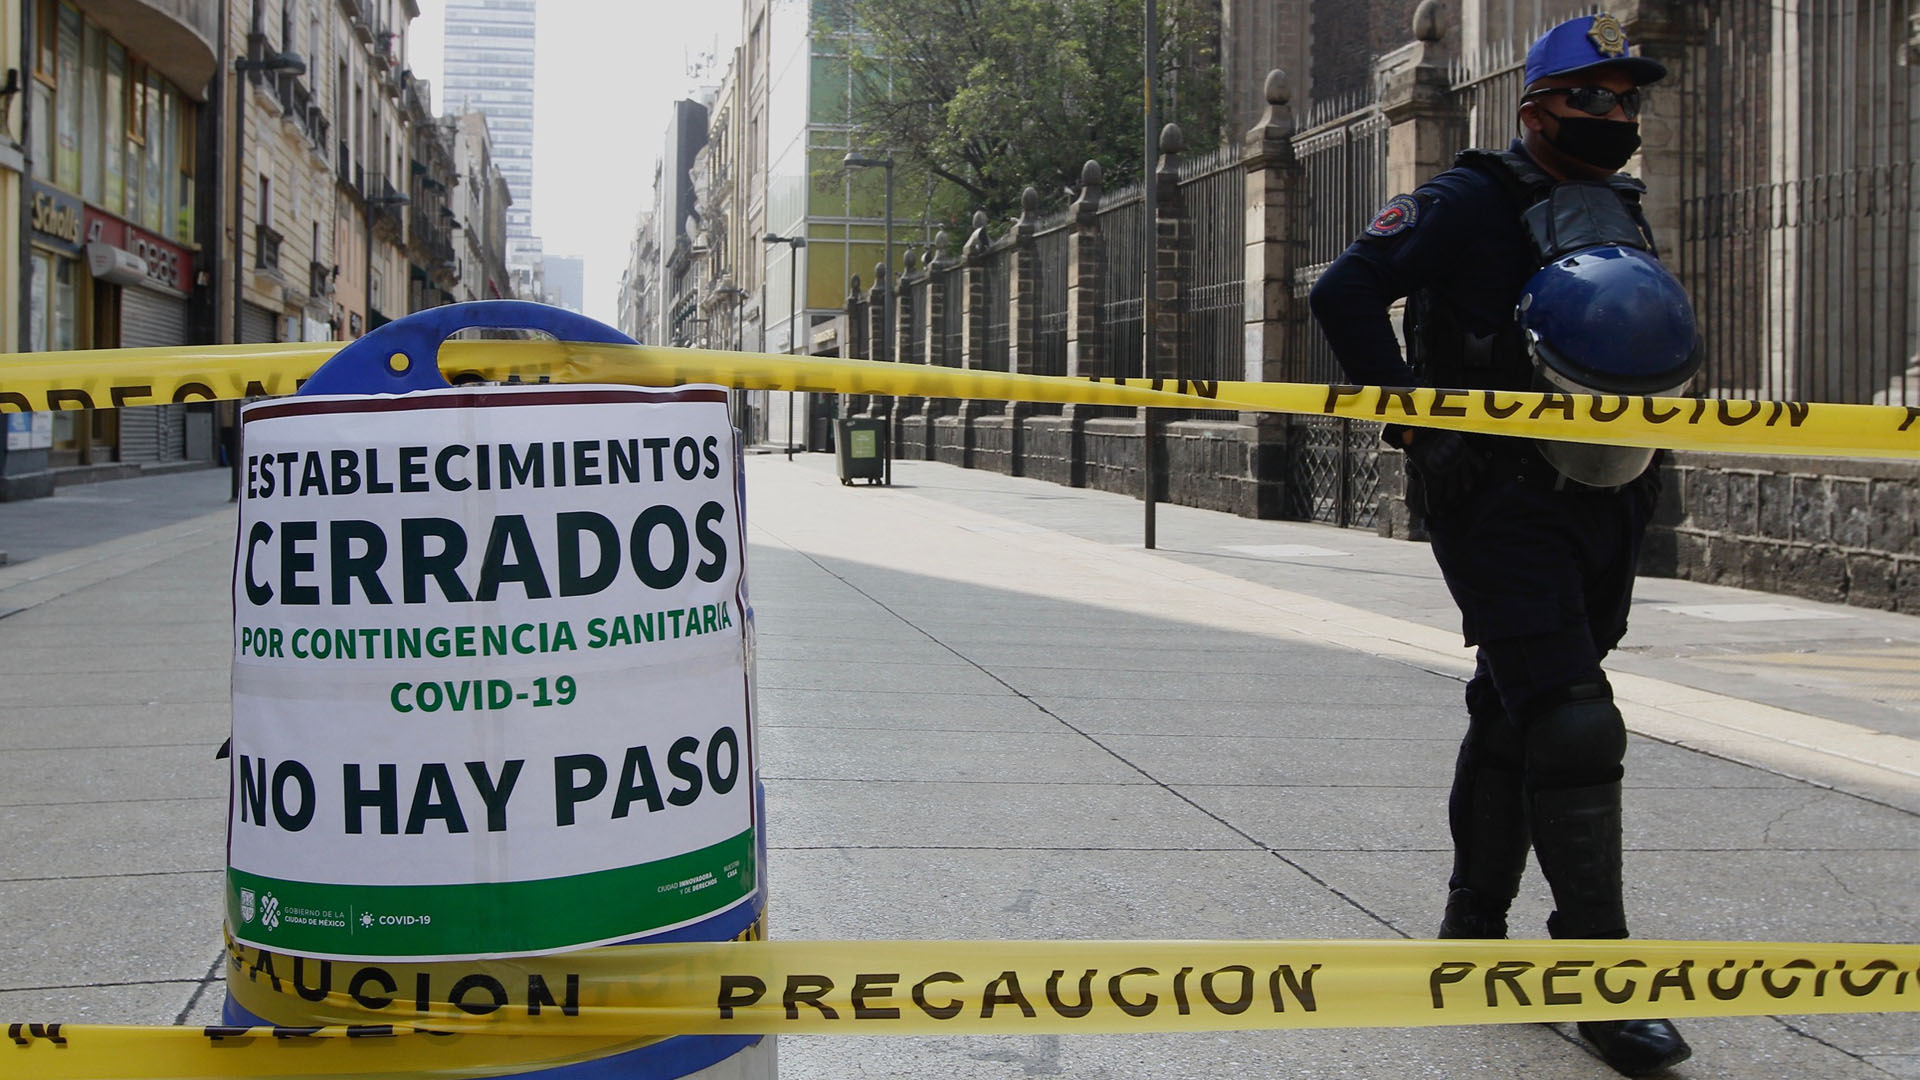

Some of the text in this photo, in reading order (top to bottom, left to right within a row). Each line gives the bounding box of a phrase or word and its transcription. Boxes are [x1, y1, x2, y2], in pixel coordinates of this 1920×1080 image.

[247, 435, 721, 500] ESTABLECIMIENTOS
[244, 500, 728, 607] CERRADOS
[241, 600, 734, 660] POR CONTINGENCIA SANITARIA
[390, 675, 578, 713] COVID-19
[239, 726, 740, 835] NO HAY PASO
[657, 871, 713, 893] CIUDAD INNOVADORA
[692, 877, 718, 892] DERECHOS
[284, 906, 320, 917] GOBIERNO
[335, 911, 345, 919] LA
[284, 916, 308, 924] CIUDAD
[318, 917, 346, 928] MÉXICO
[378, 915, 432, 926] COVID-19
[232, 944, 580, 1017] AUCION
[716, 964, 1322, 1020] PRECAUCION
